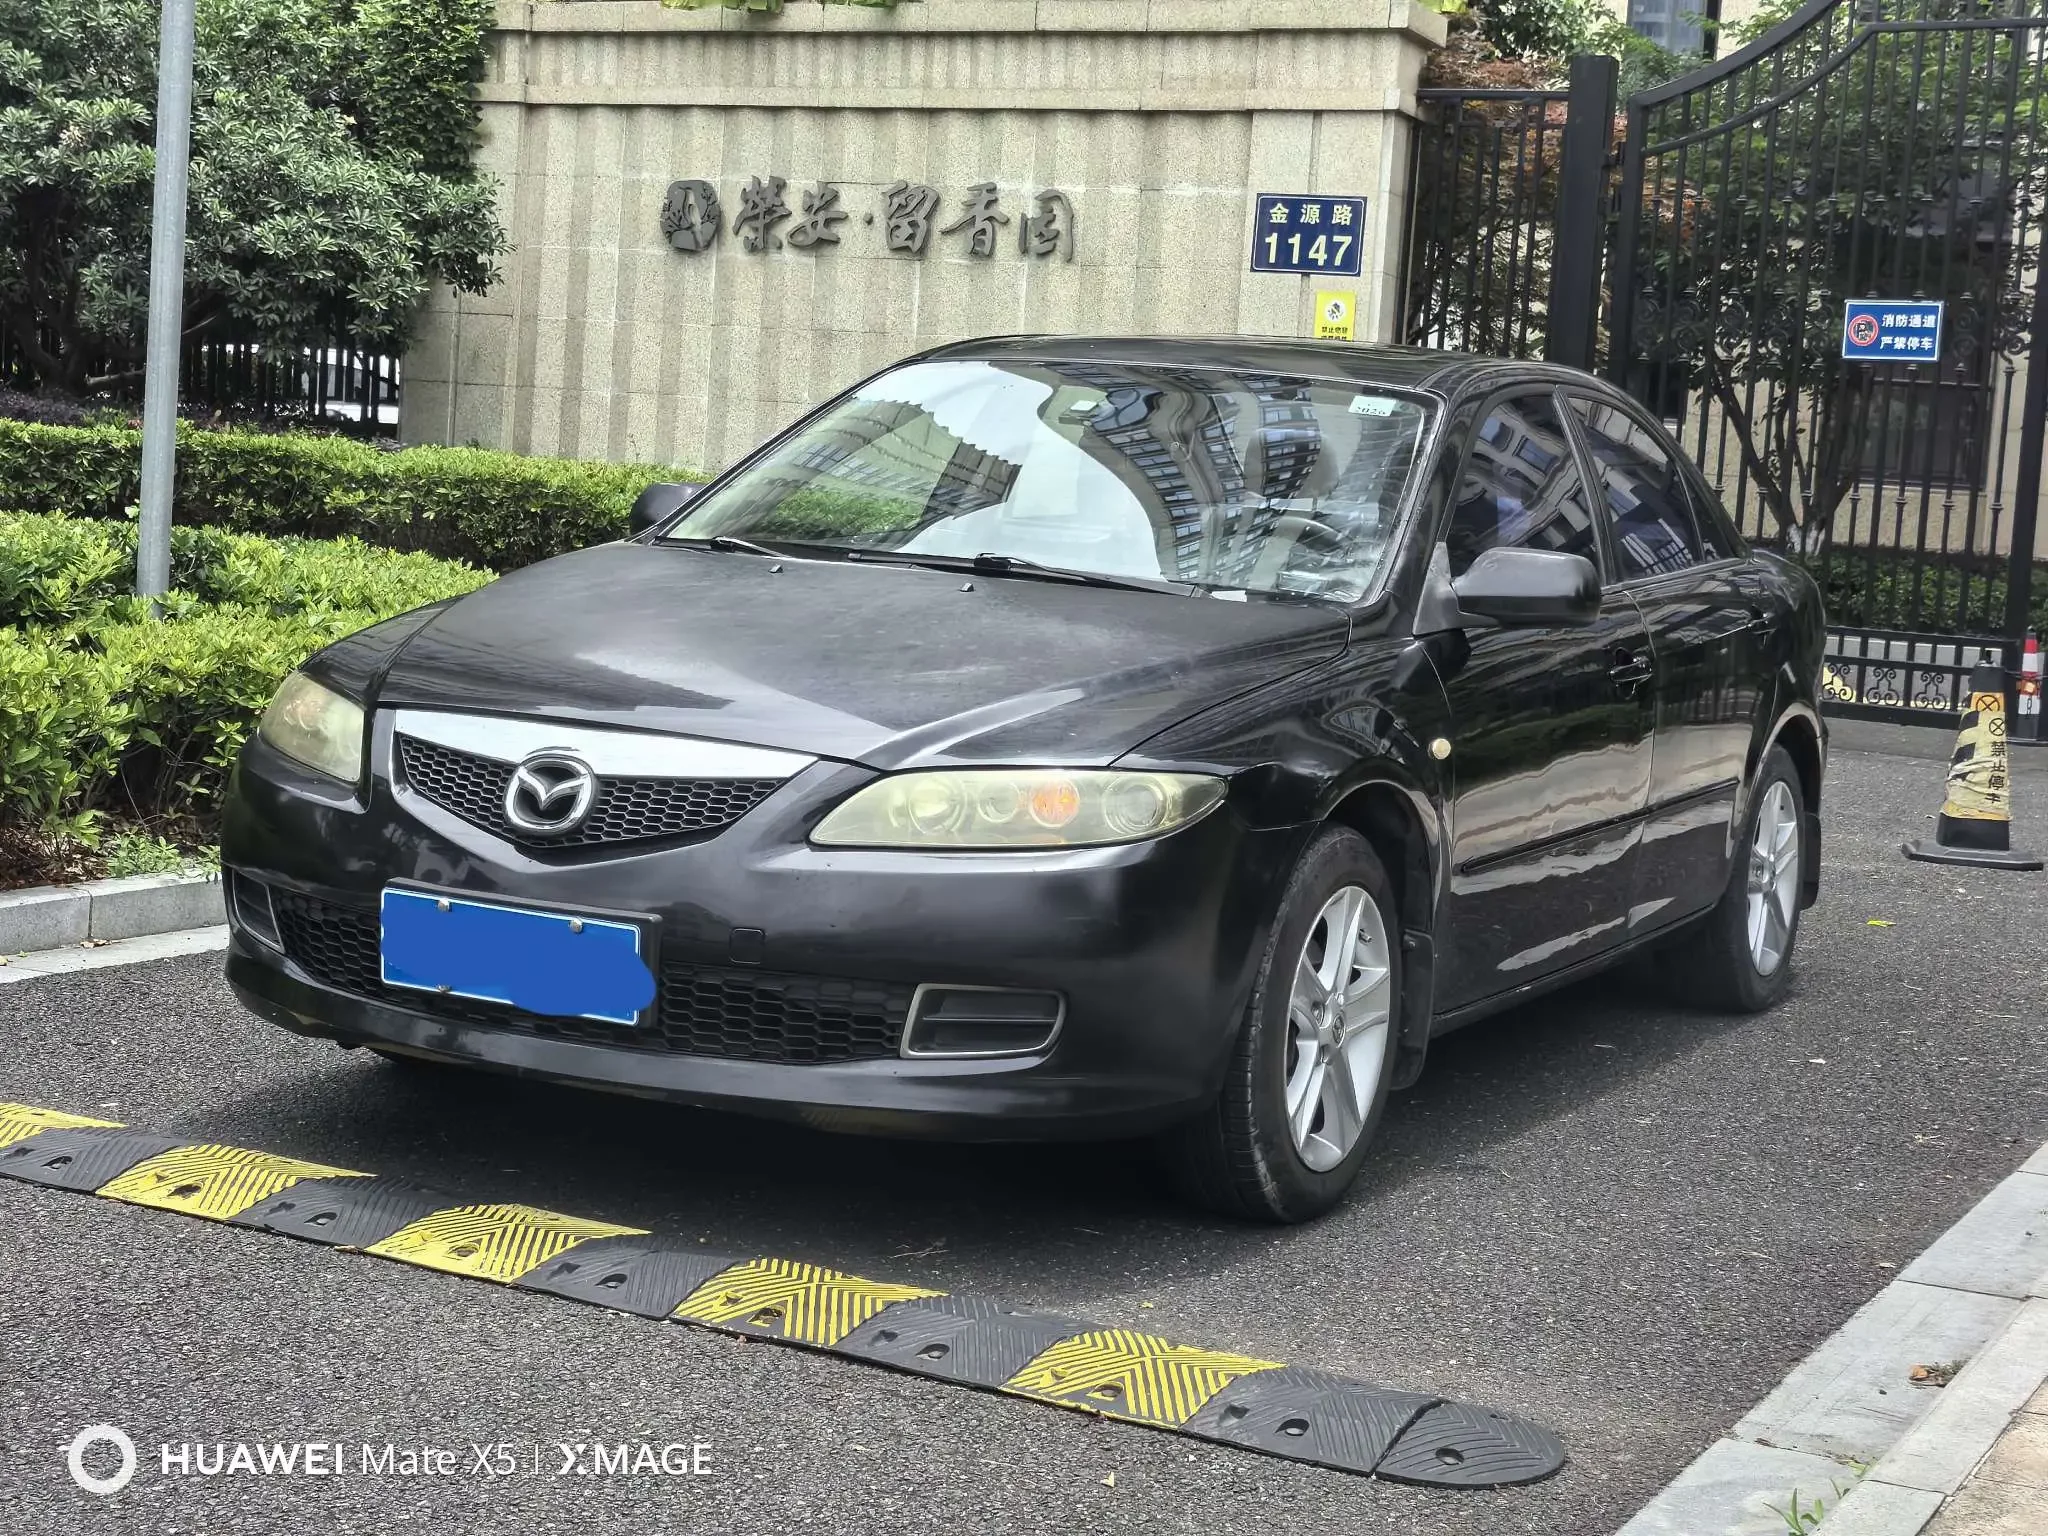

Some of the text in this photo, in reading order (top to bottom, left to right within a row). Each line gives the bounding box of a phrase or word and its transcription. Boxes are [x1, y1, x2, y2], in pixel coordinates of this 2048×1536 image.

[1269, 203, 1352, 225] 金源路
[1265, 232, 1352, 267] 1147
[1881, 314, 1936, 328] 消防通道
[1880, 336, 1933, 350] 严禁停车
